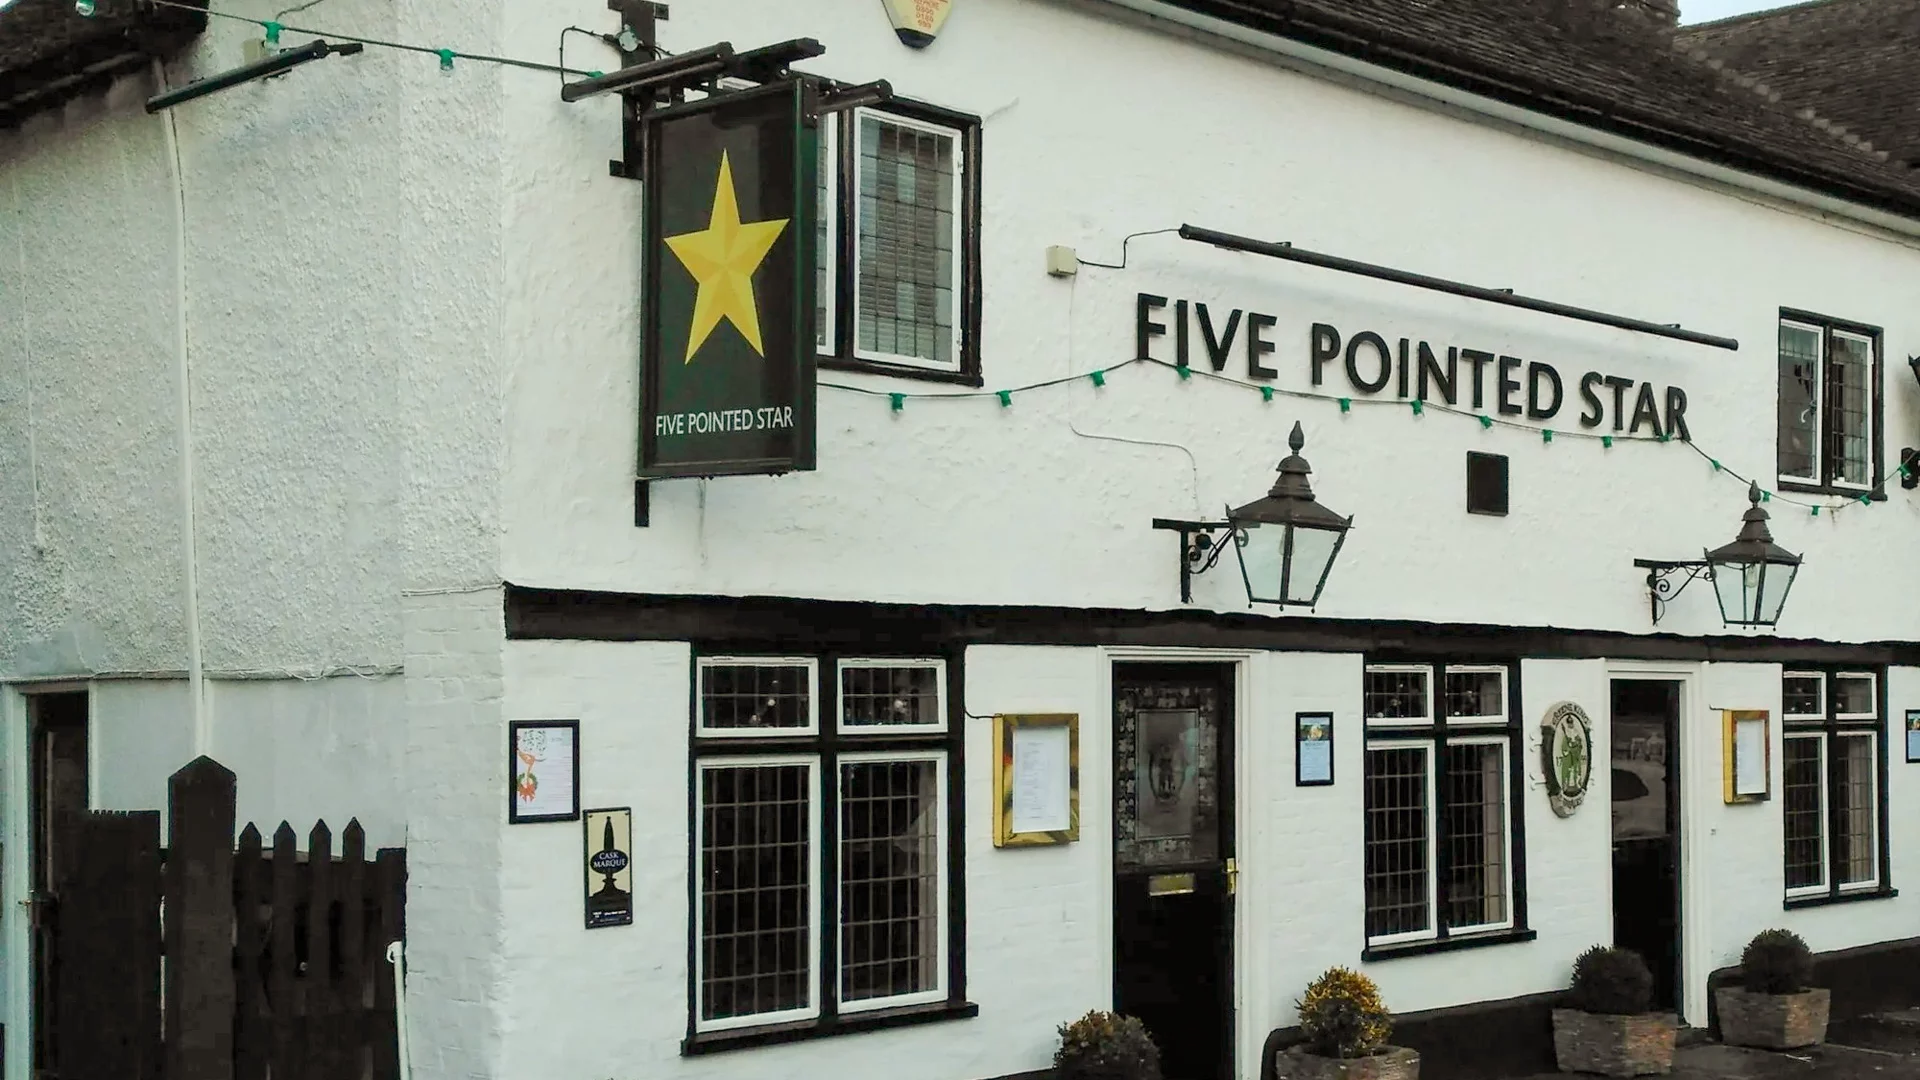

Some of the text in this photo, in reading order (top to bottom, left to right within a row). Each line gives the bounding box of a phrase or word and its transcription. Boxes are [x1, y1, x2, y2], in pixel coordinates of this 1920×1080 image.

[1137, 292, 1692, 441] FIVE POINTED STAR
[655, 405, 794, 436] FIVE POINTED STAR
[593, 858, 626, 868] MARQUE
[599, 851, 620, 860] CASK
